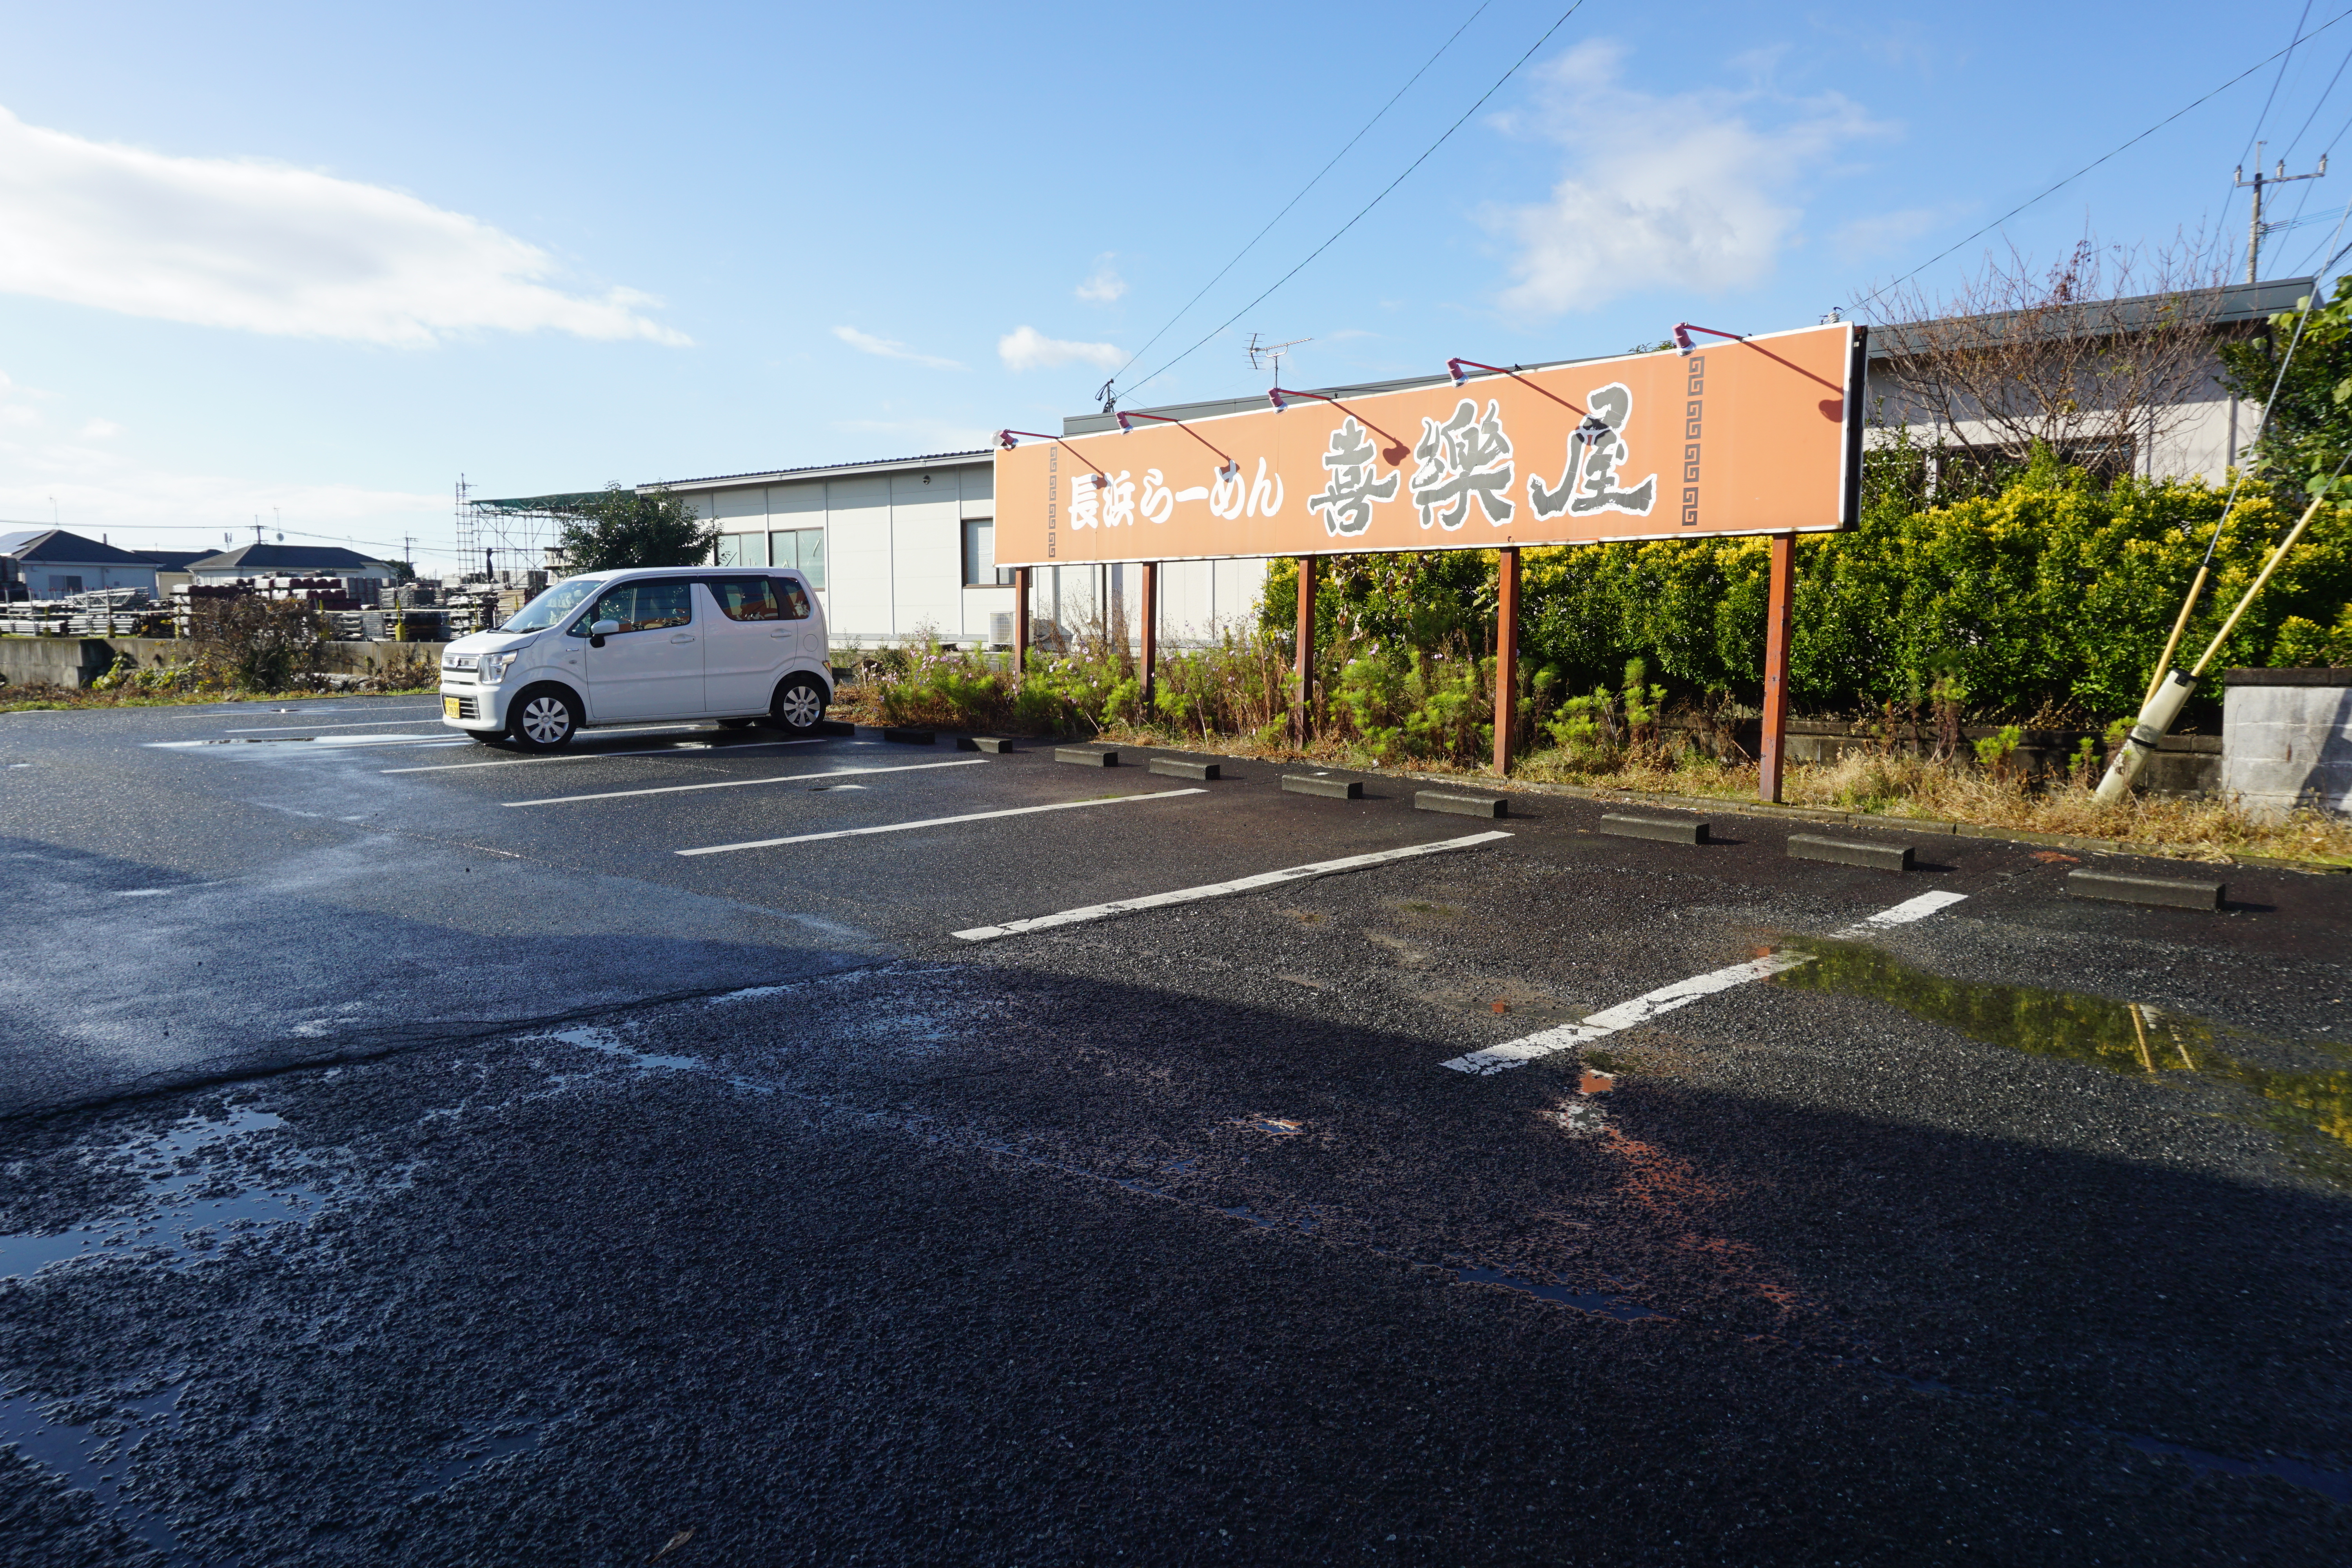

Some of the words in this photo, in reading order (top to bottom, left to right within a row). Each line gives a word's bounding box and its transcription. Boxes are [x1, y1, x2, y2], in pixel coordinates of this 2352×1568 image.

[1068, 457, 1284, 530] 長浜らーめん
